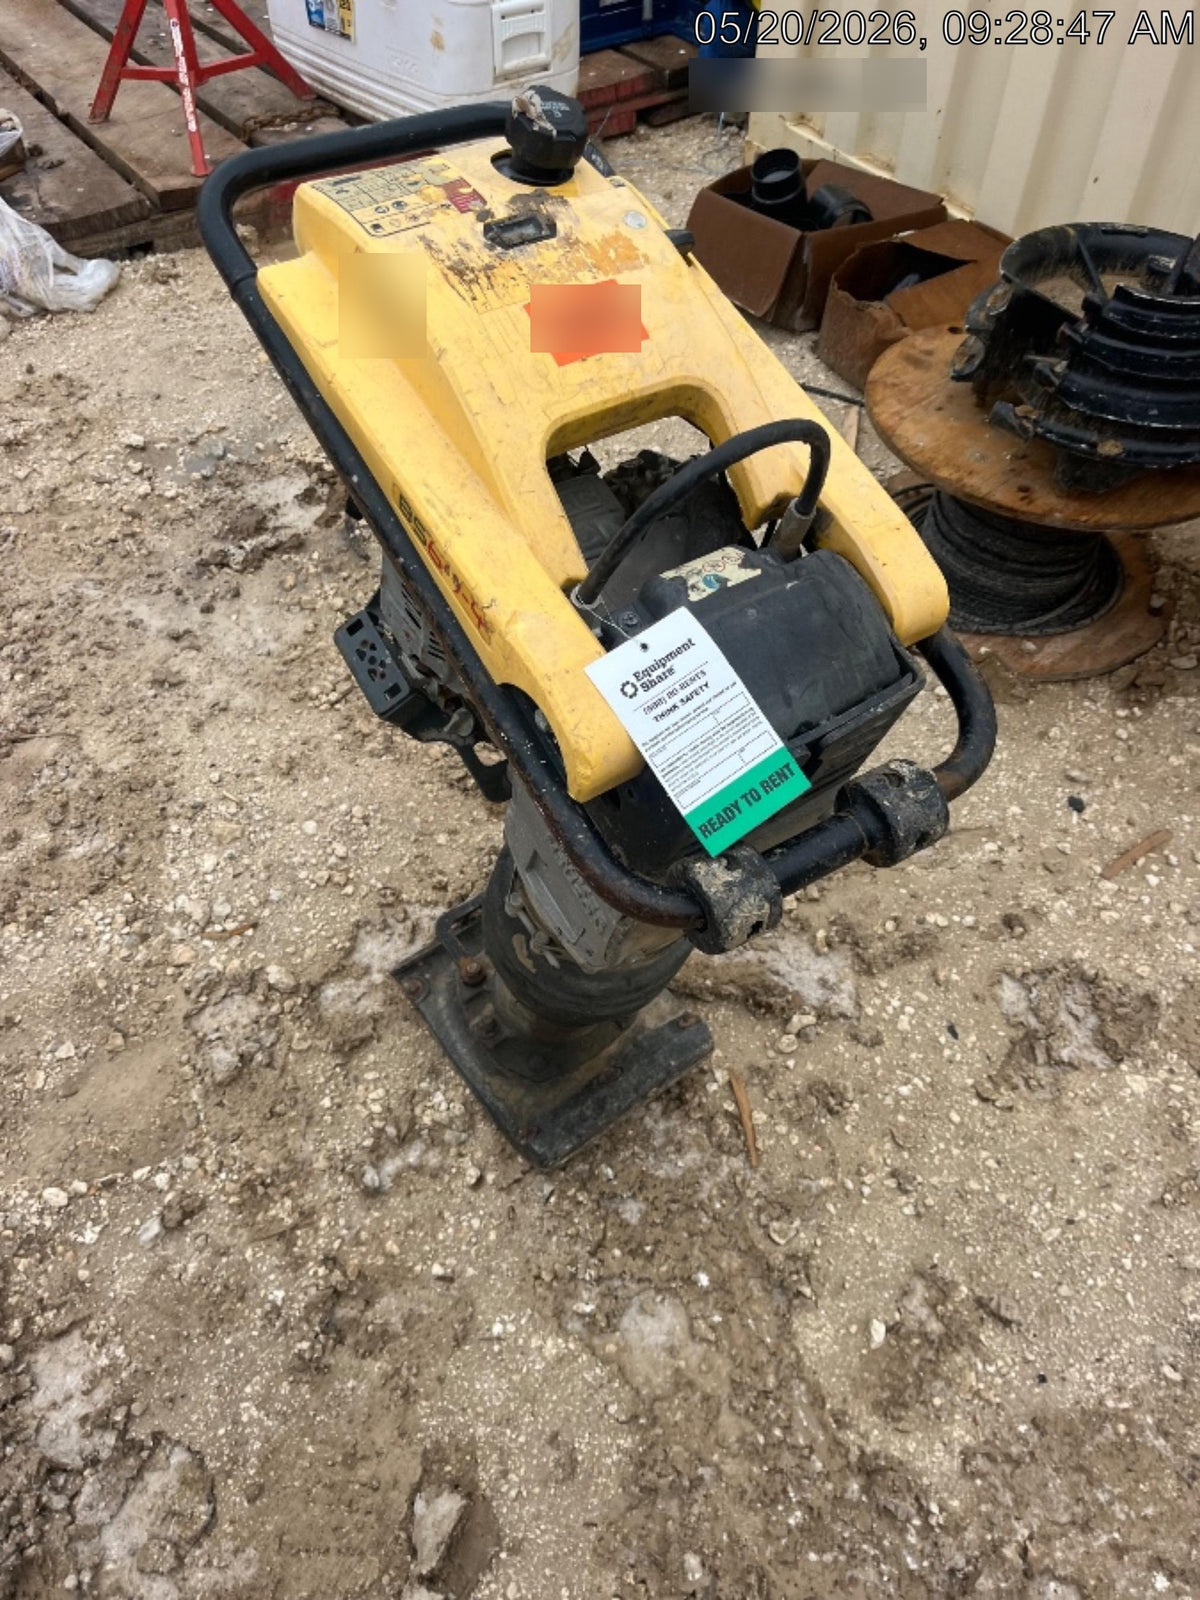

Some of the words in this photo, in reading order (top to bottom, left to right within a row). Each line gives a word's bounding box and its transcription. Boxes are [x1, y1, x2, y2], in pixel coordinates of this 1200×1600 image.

[633, 638, 696, 681] Equipment
[640, 665, 675, 692] Share
[653, 702, 680, 722] THINK
[679, 681, 710, 706] SAFETY
[698, 800, 742, 839] READY
[740, 787, 762, 807] TO
[759, 762, 795, 795] RENT
